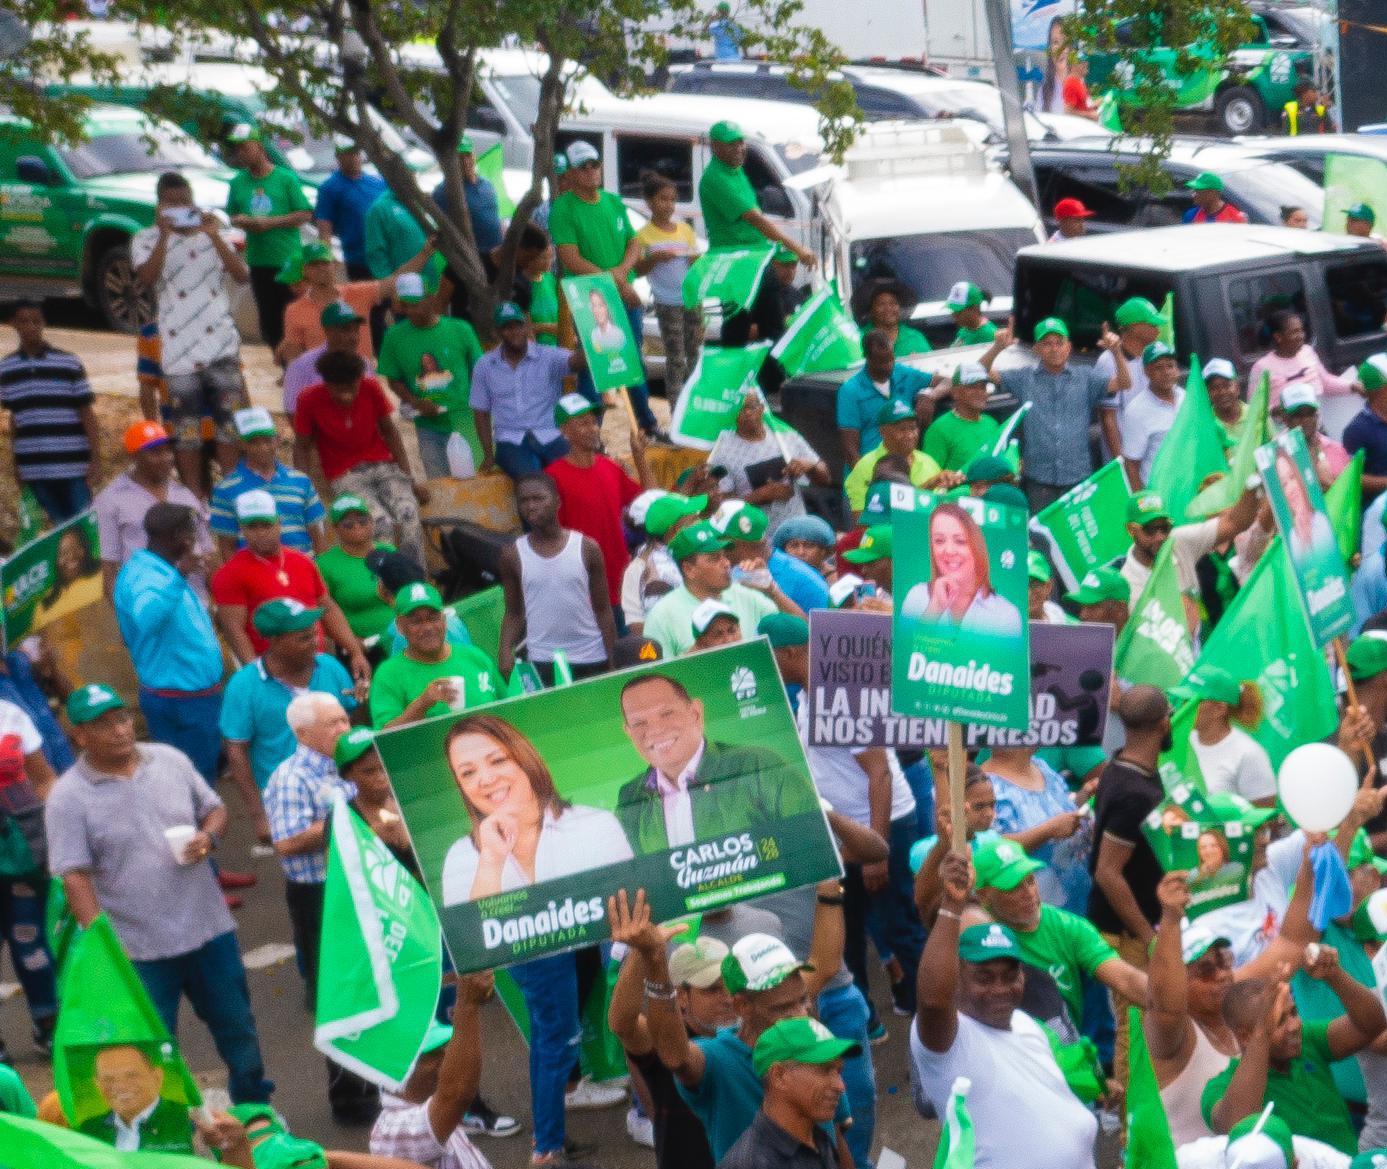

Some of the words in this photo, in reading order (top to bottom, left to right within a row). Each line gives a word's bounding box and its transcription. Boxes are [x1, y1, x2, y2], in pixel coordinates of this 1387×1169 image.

[819, 634, 834, 657] Y
[818, 661, 878, 686] VISTO
[907, 651, 1014, 697] Danaides
[815, 686, 855, 718] LA
[814, 715, 874, 745] NOS
[966, 720, 1080, 746] PRESOS
[669, 832, 755, 868] CARLOS
[676, 853, 760, 891] Guzmán
[697, 873, 745, 892] ALCALDE
[481, 896, 605, 949] Danaides
[511, 926, 588, 955] DIPUTADA
